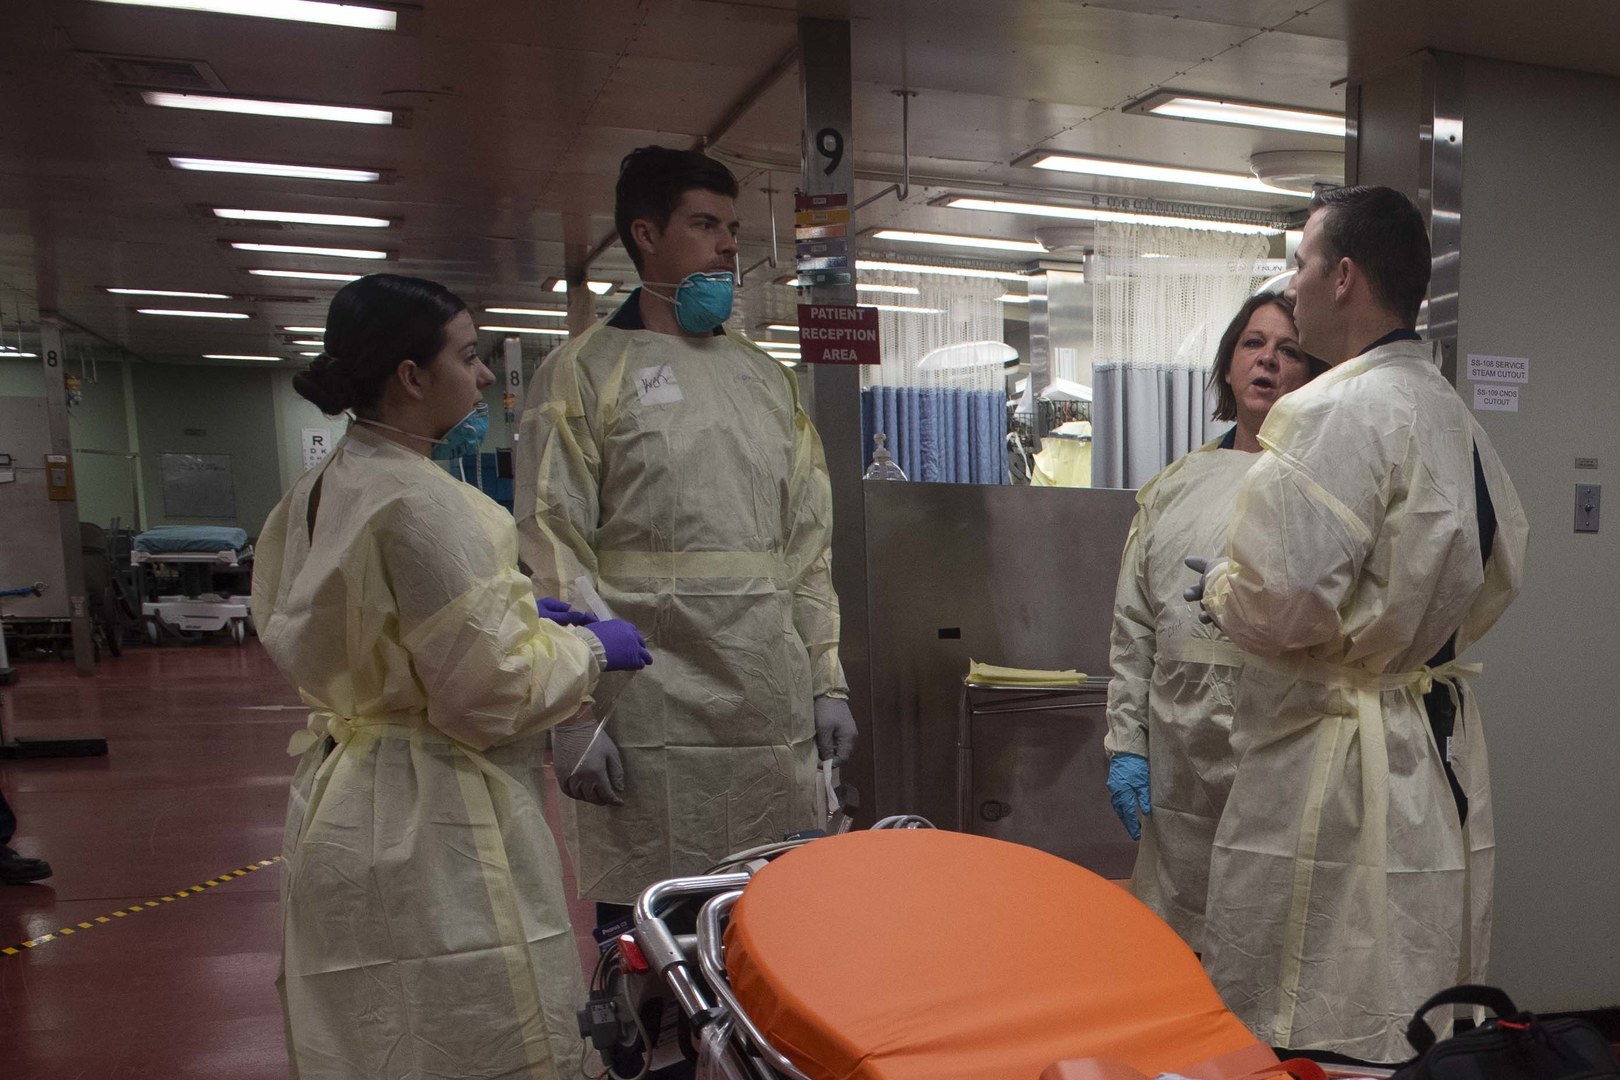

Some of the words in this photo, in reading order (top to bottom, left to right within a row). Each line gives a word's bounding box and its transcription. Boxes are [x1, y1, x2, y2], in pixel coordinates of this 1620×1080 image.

[816, 127, 844, 176] 9
[810, 307, 865, 321] PATIENT
[801, 328, 876, 342] RECEPTION
[47, 350, 58, 367] 8
[822, 348, 858, 361] AREA
[1495, 361, 1525, 370] SERVICE
[510, 370, 520, 386] 8
[1472, 368, 1496, 377] STEAM
[1497, 371, 1526, 379] CUTOUT
[1483, 398, 1510, 406] CUTOUT
[312, 435, 324, 446] R
